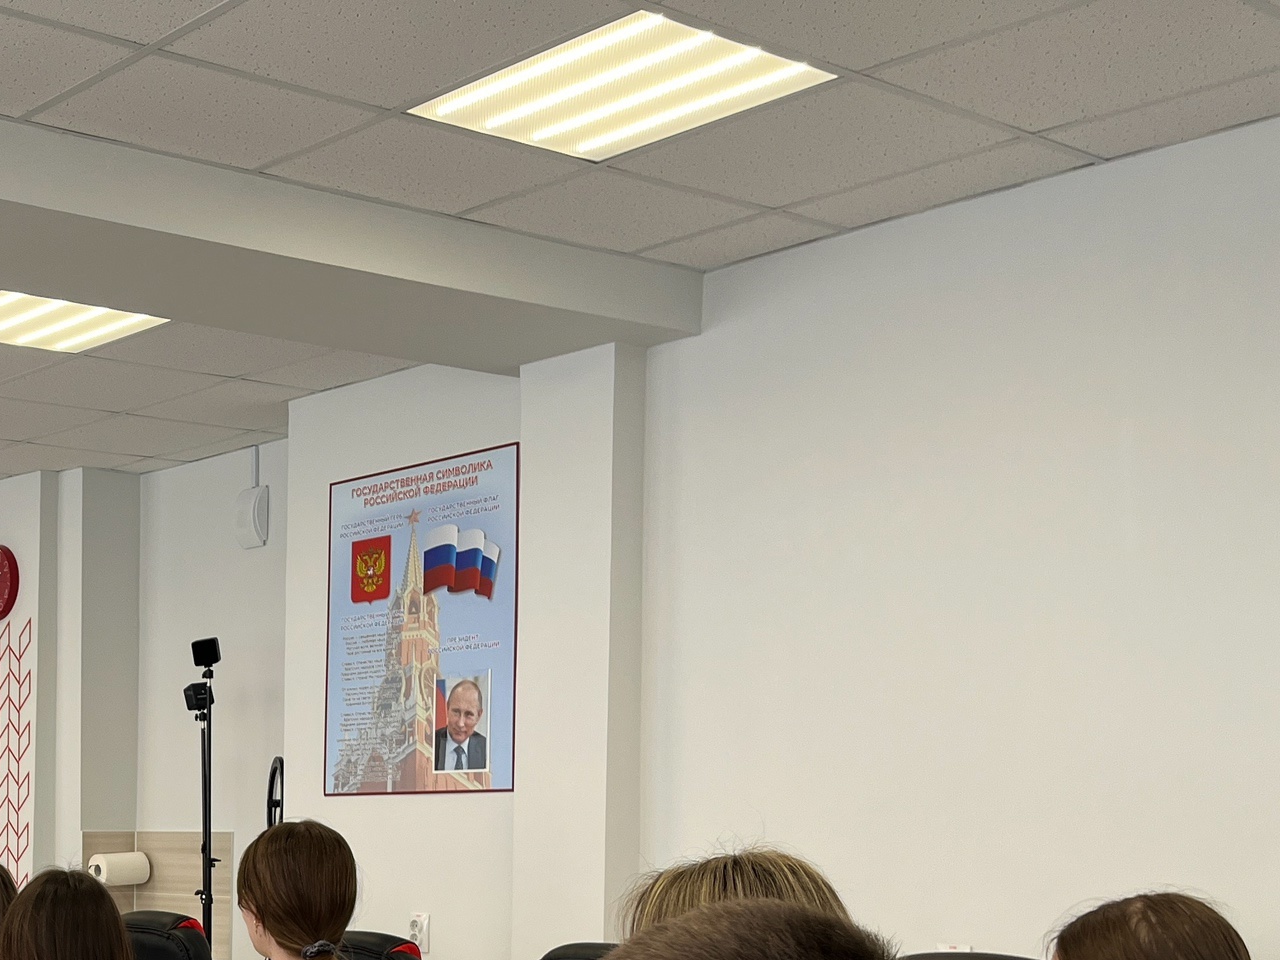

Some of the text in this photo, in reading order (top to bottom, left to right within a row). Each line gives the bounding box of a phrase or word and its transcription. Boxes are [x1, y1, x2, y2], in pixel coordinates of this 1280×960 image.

[351, 459, 493, 499] ГОСУДАРСТВЕННАЯ СИМВОЛИКА
[363, 475, 478, 508] РОССИЙСКОЙ ФЕДЕРАЦИИ
[427, 504, 500, 522] РОССИЙСКОЙ ФЕДЕРАЦИИ
[340, 522, 404, 539] РОССИЙСКОЙ ФЕДЕРАЦИИ
[3, 560, 9, 571] 2
[465, 641, 500, 650] ФЕДЕРАЦИИ
